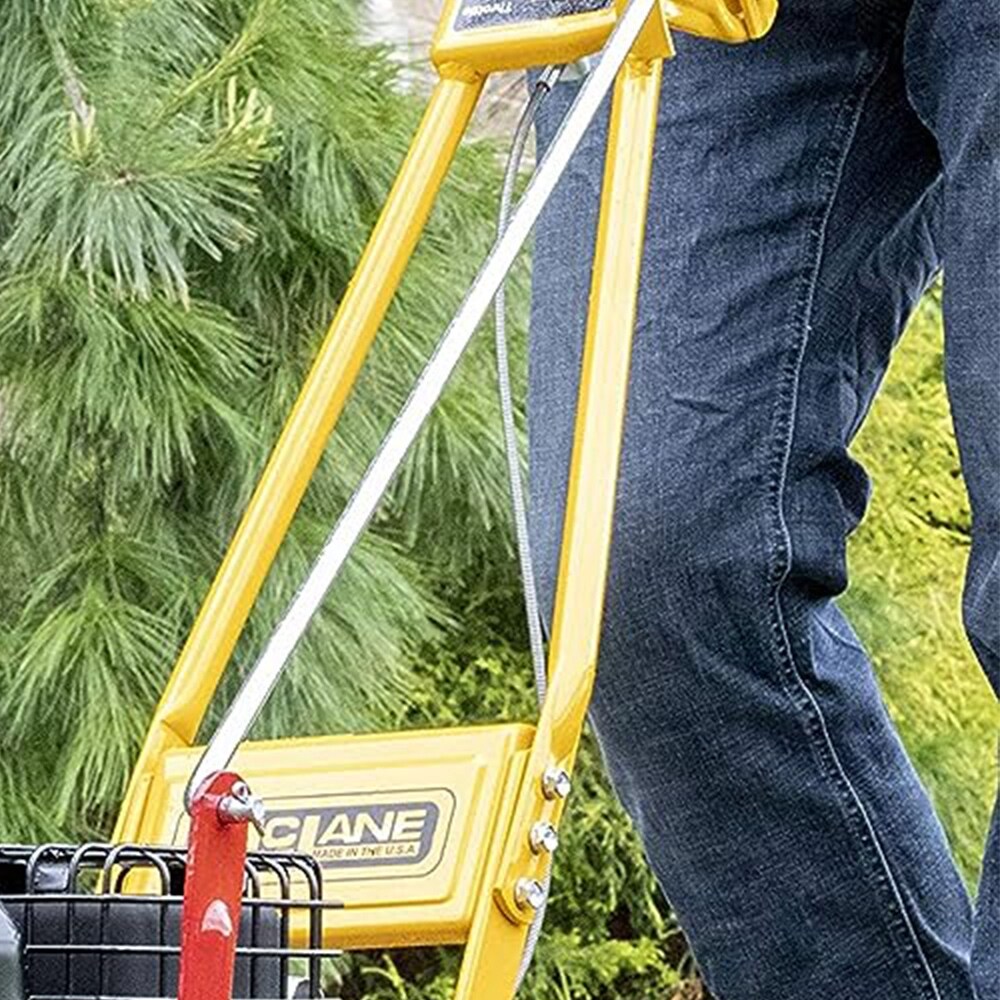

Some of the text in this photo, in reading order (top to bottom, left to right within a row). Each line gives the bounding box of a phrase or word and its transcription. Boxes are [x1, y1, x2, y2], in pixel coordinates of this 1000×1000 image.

[248, 809, 427, 851] CLANE
[312, 848, 343, 858] MADE
[346, 847, 358, 857] IN
[361, 846, 382, 857] THE
